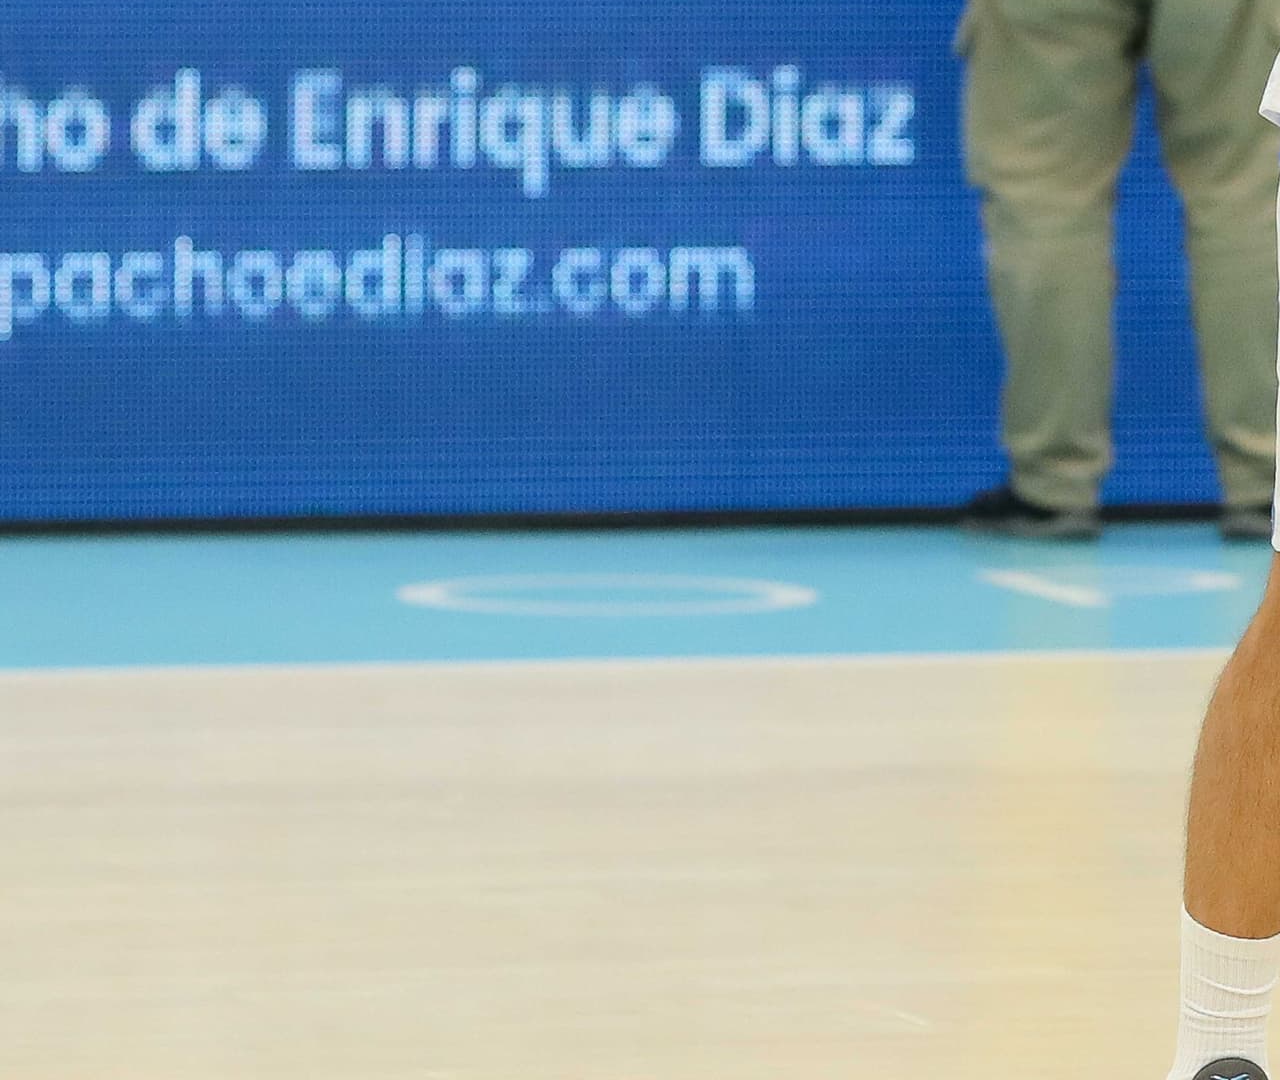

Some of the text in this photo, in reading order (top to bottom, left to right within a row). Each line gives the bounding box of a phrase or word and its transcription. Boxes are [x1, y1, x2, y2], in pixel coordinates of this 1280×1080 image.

[129, 67, 268, 171] de
[289, 66, 679, 198] Enrique
[699, 64, 915, 168] Diaz
